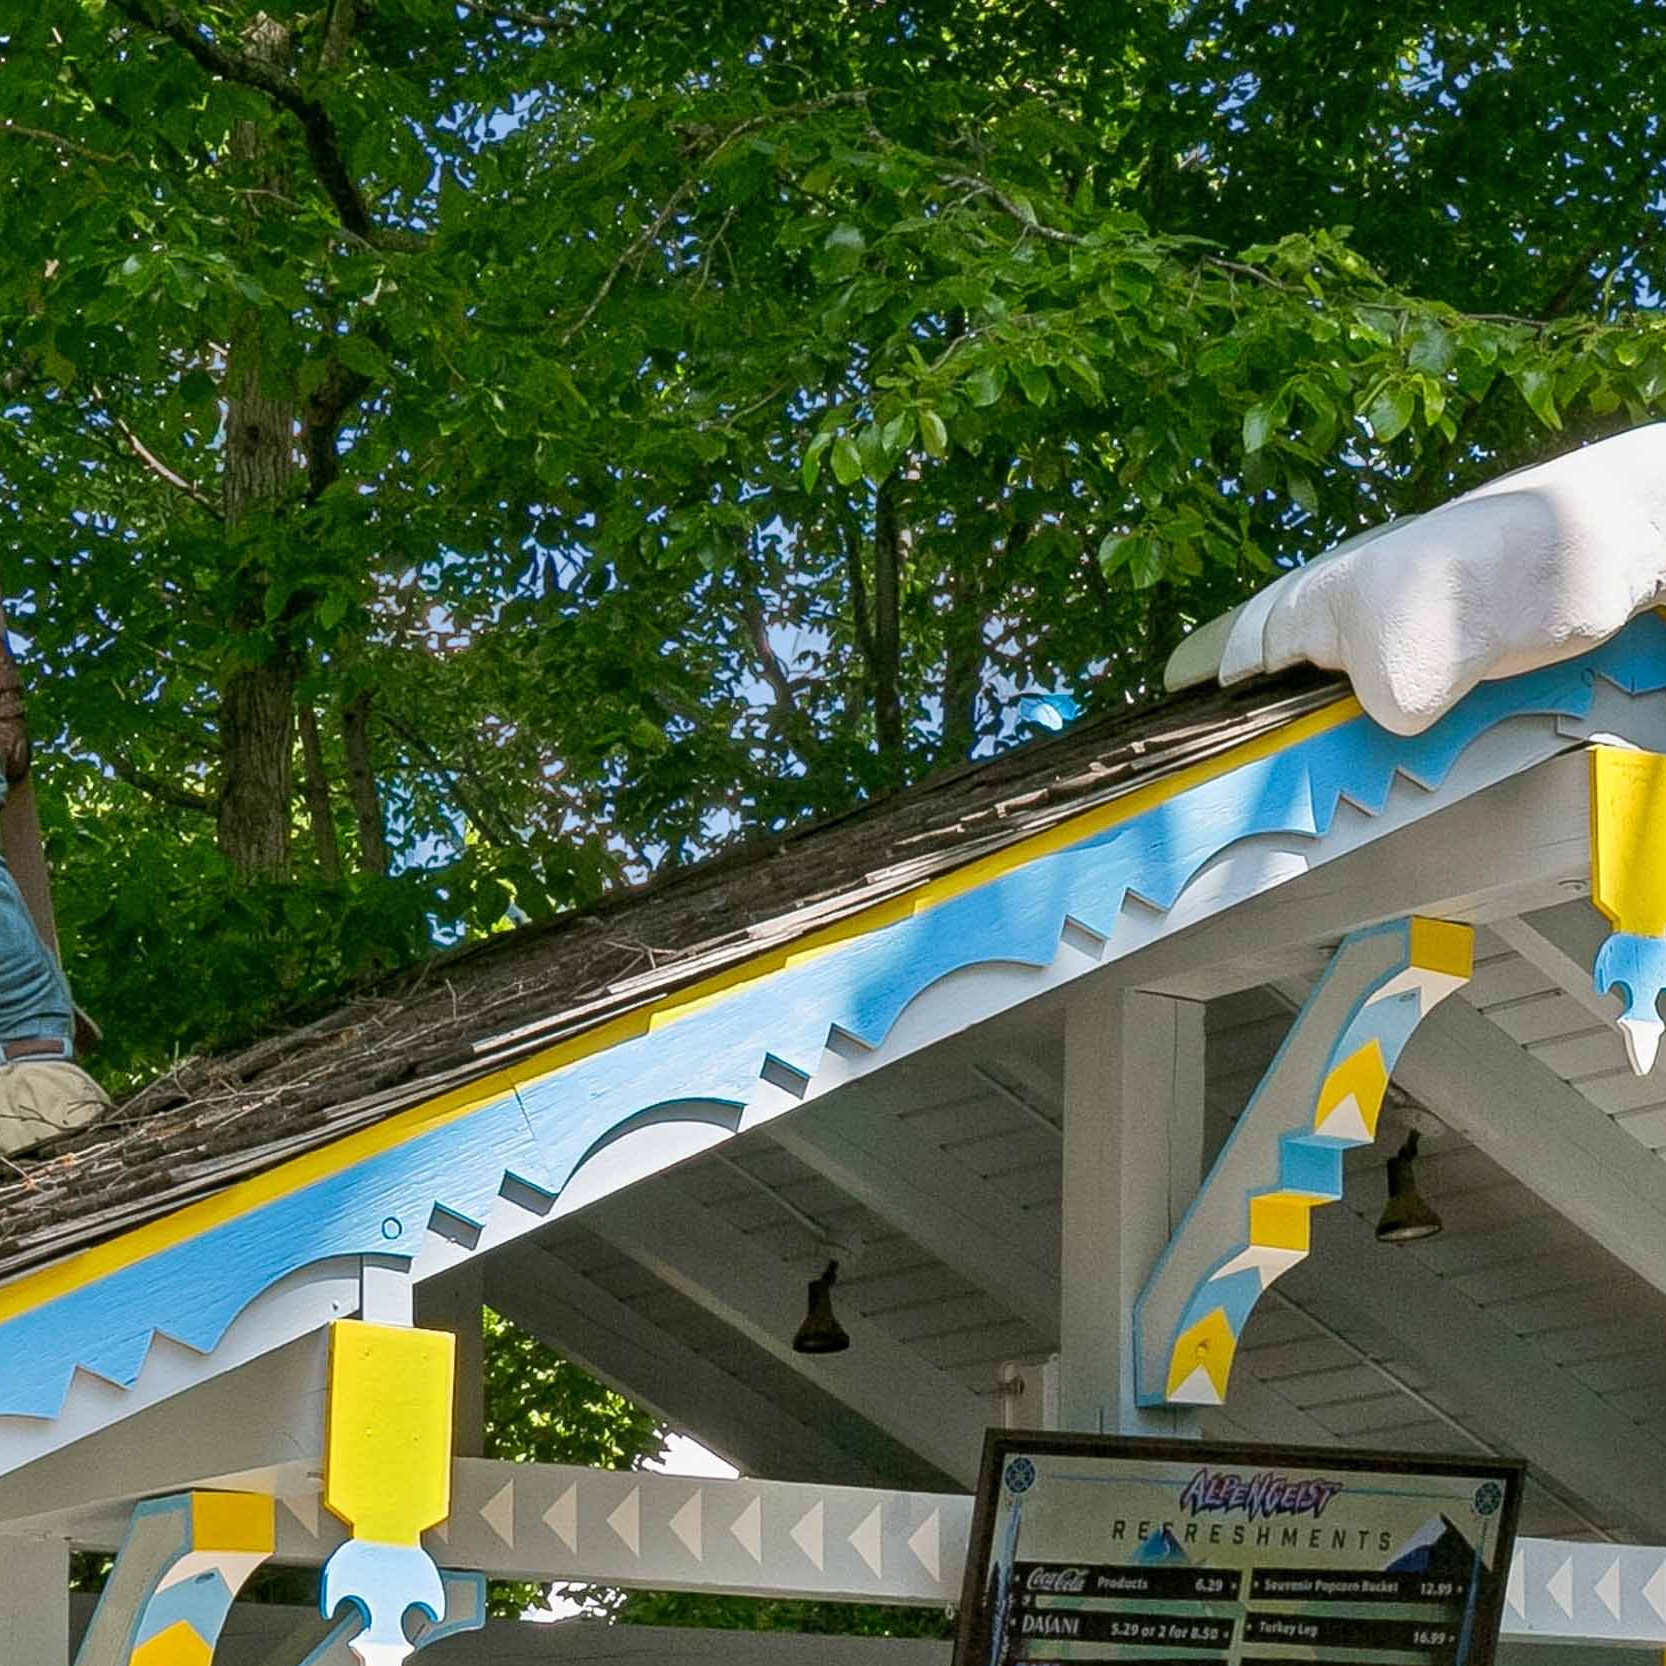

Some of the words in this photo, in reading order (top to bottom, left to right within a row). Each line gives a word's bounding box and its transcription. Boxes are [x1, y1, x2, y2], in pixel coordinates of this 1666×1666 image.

[1112, 1519, 1392, 1551] REFRESHMENTS
[1097, 1575, 1149, 1591] Products
[1195, 1578, 1224, 1592] 6.29
[1315, 1579, 1361, 1595] Popcorn
[1362, 1580, 1398, 1593] Bucket
[1021, 1614, 1080, 1635] DASANI
[1110, 1622, 1138, 1636] 5.29
[1141, 1625, 1156, 1637] or
[1158, 1624, 1167, 1637] 2
[1168, 1624, 1188, 1638] for
[1259, 1621, 1296, 1636] Turkey
[1297, 1624, 1318, 1638] Leg
